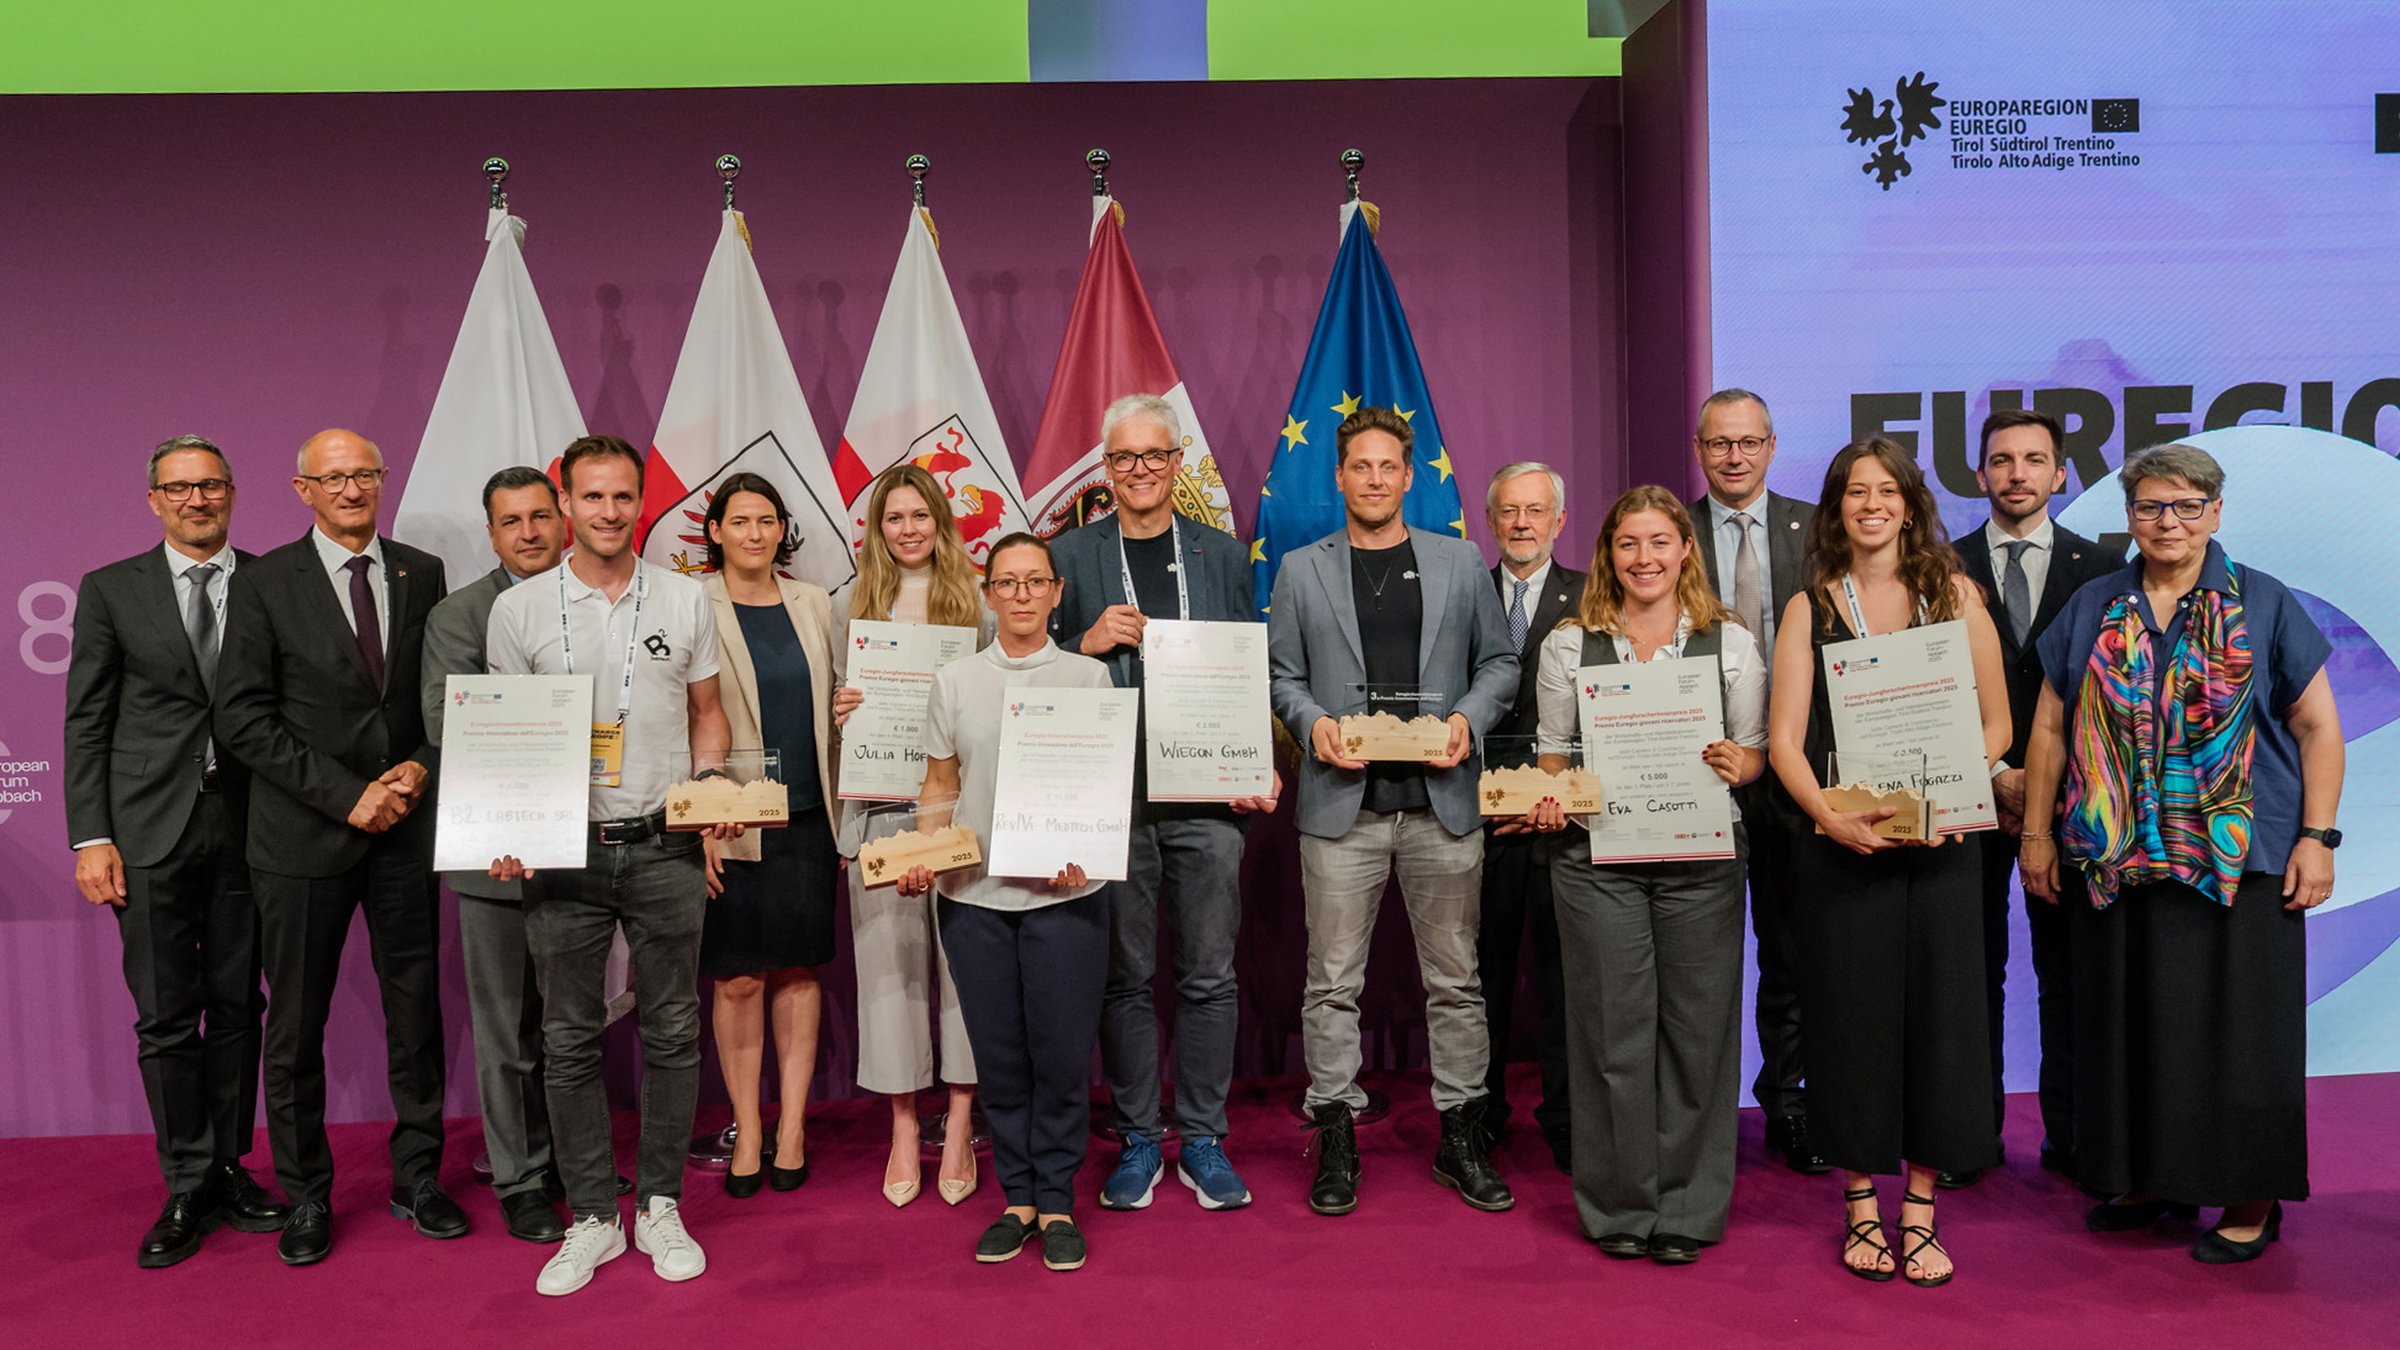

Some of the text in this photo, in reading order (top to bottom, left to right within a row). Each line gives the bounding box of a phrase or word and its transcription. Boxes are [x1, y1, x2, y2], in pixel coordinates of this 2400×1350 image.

[1950, 100, 2088, 117] EUROPAREGION
[1950, 118, 2027, 135] EUREGIO
[1951, 135, 2115, 152] Tirol Südtirol Trentino
[1951, 152, 2140, 171] Tirolo Alto Adige Trentino
[1851, 378, 2400, 498] EURE
[1424, 749, 1443, 757] 2025
[1647, 772, 1669, 781] 5.000
[1571, 800, 1594, 808] 2025
[758, 808, 781, 817] 2025
[1892, 825, 1912, 833] 2025
[951, 852, 973, 863] 2025
